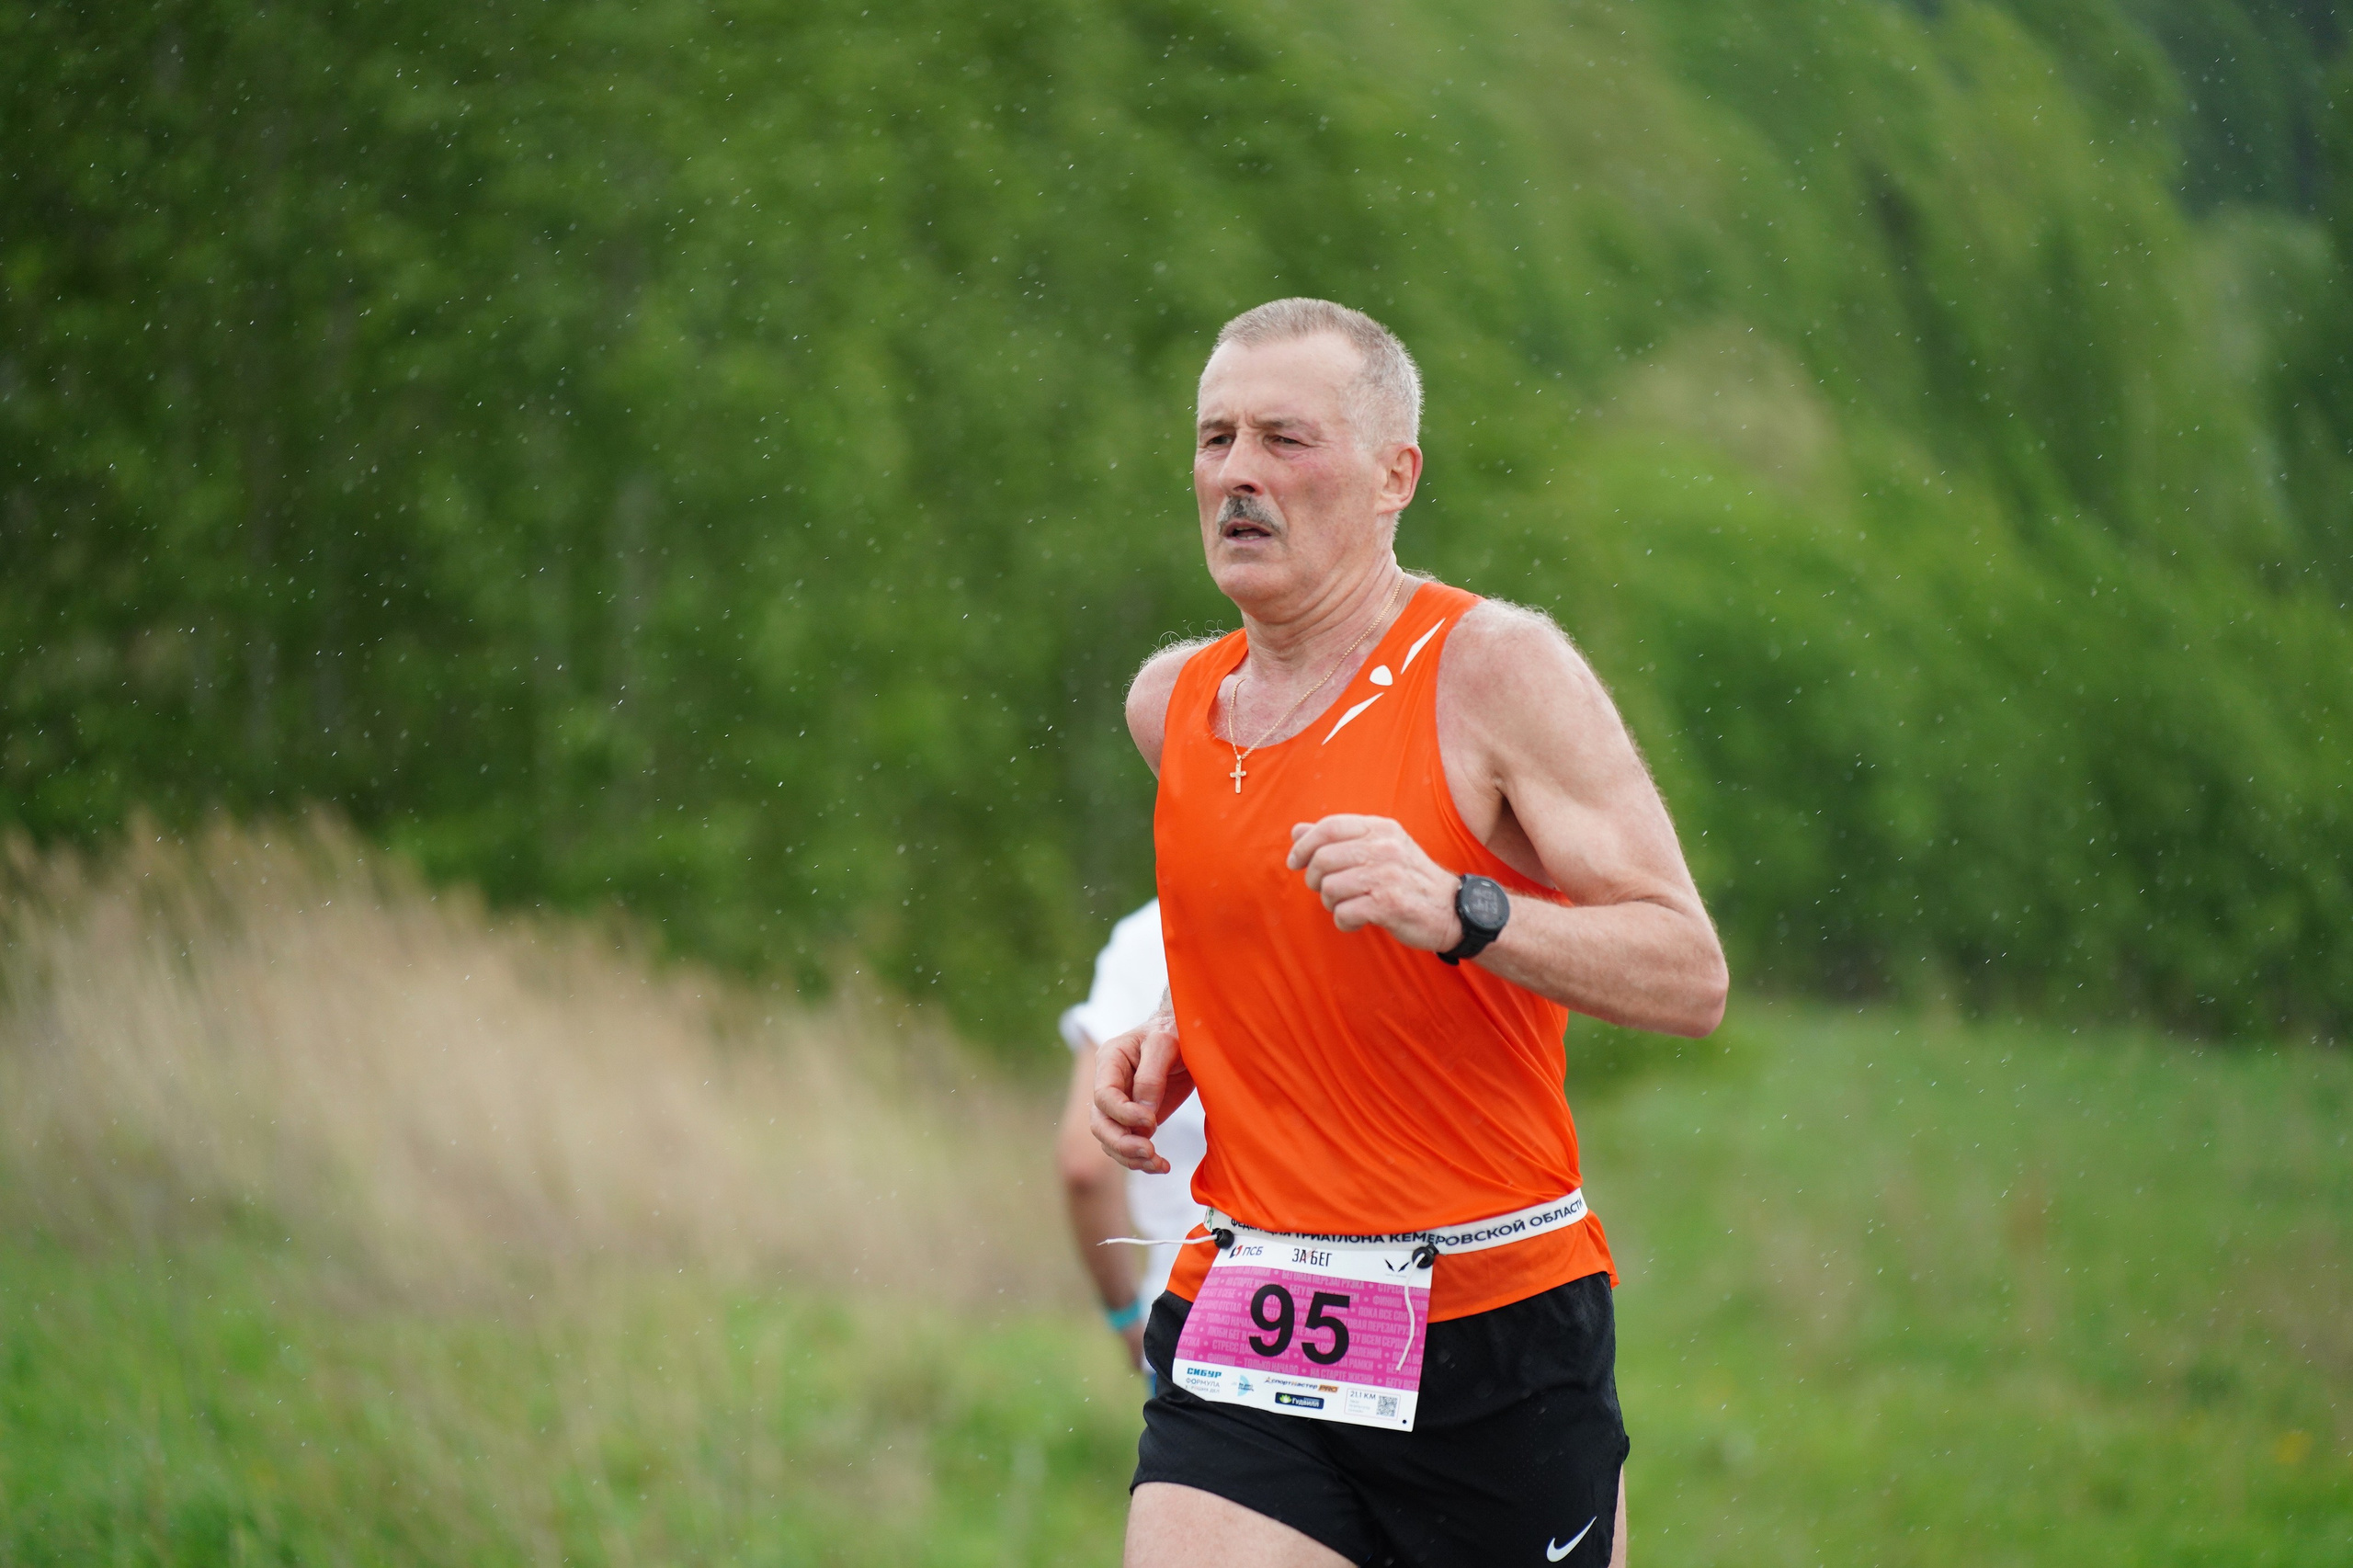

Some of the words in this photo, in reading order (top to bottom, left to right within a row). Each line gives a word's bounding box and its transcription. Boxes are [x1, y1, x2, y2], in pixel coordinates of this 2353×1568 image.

[1390, 1220, 1526, 1246] КЕМЕРОВСКОЙ
[1529, 1198, 1583, 1227] ОБЛАСТИ
[1243, 1246, 1264, 1256] ПСБ
[1249, 1284, 1350, 1365] 95
[1212, 1339, 1239, 1353] СТРЕСС
[1187, 1368, 1222, 1379] СИБУР
[1186, 1378, 1221, 1388] ФОРМУЛА
